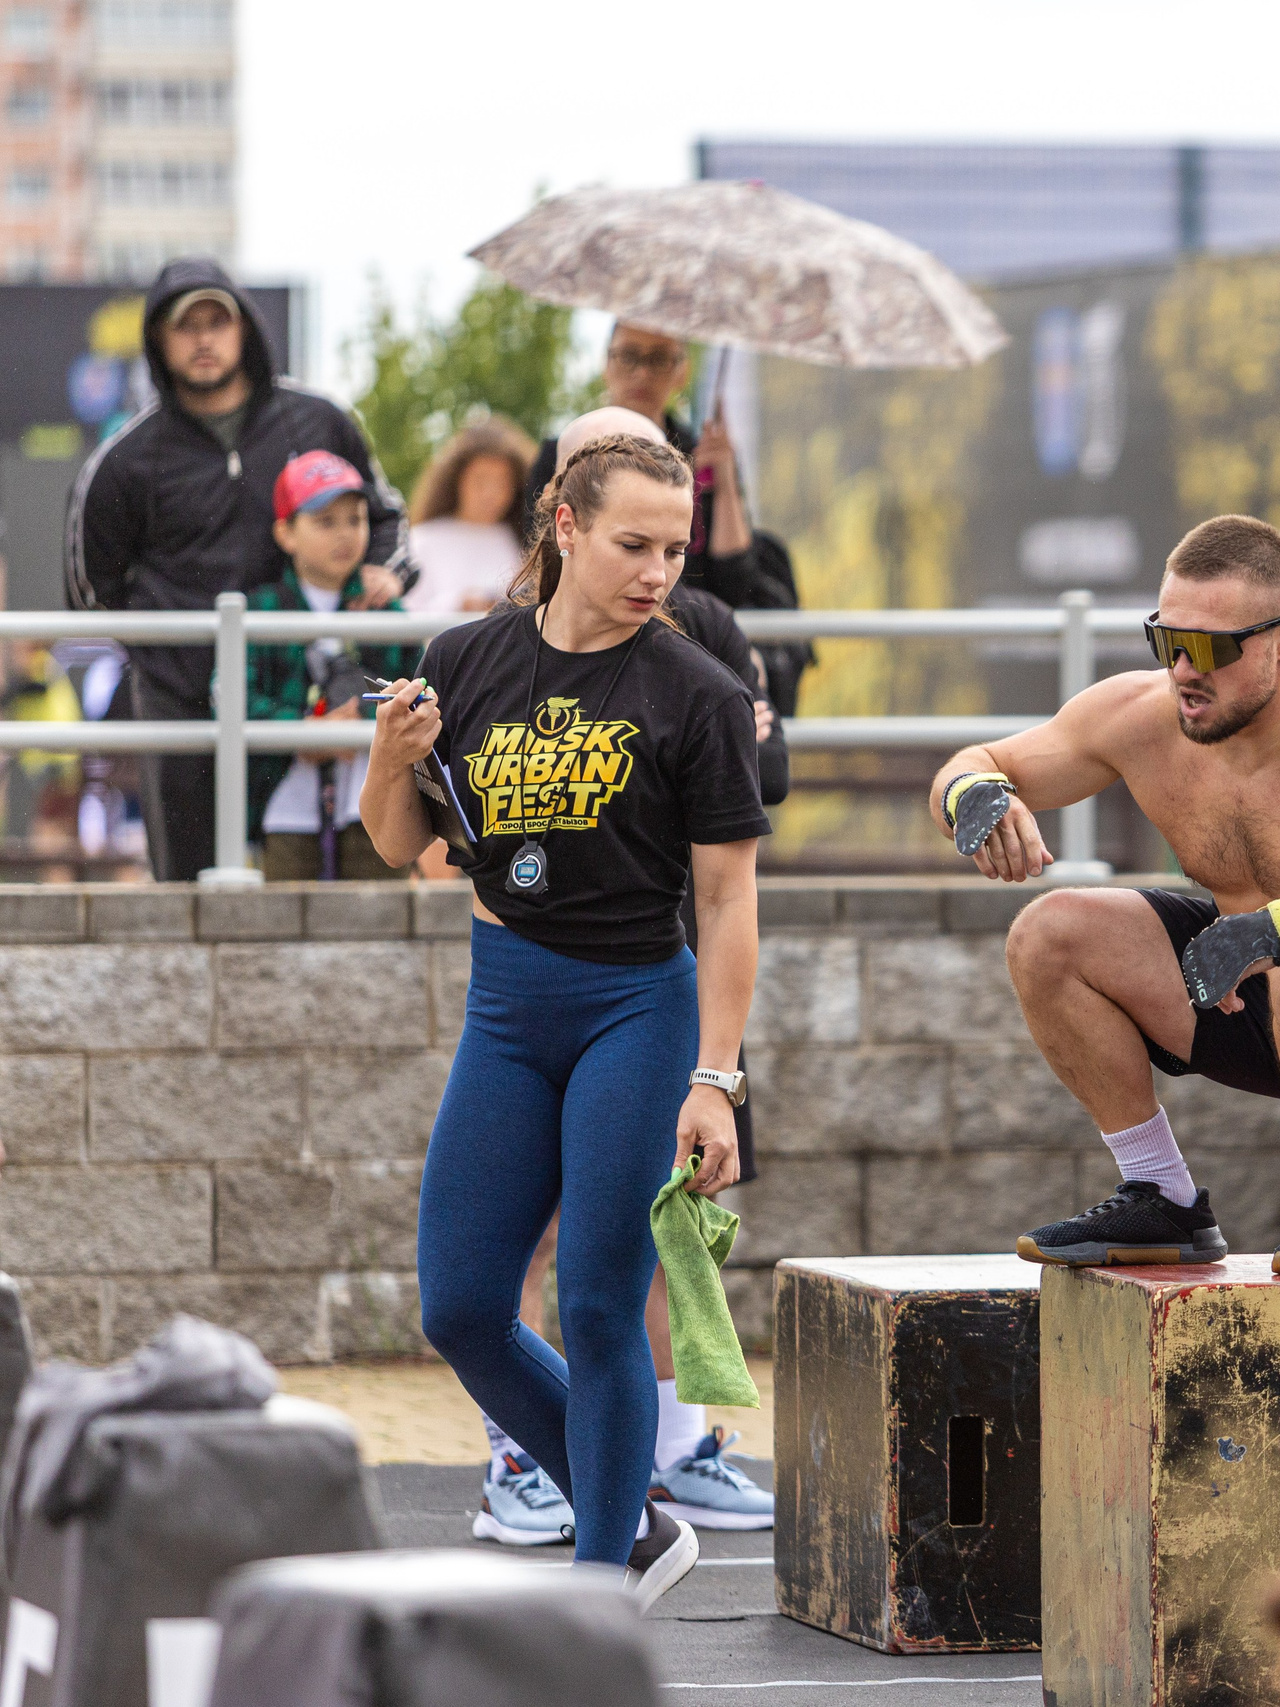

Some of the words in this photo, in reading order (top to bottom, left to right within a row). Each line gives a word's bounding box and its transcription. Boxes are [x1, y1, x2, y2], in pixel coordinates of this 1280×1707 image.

[484, 725, 625, 755] MINSK
[473, 752, 624, 788] URBAN
[486, 782, 602, 827] FEST
[527, 818, 562, 828] БРОСЕТ
